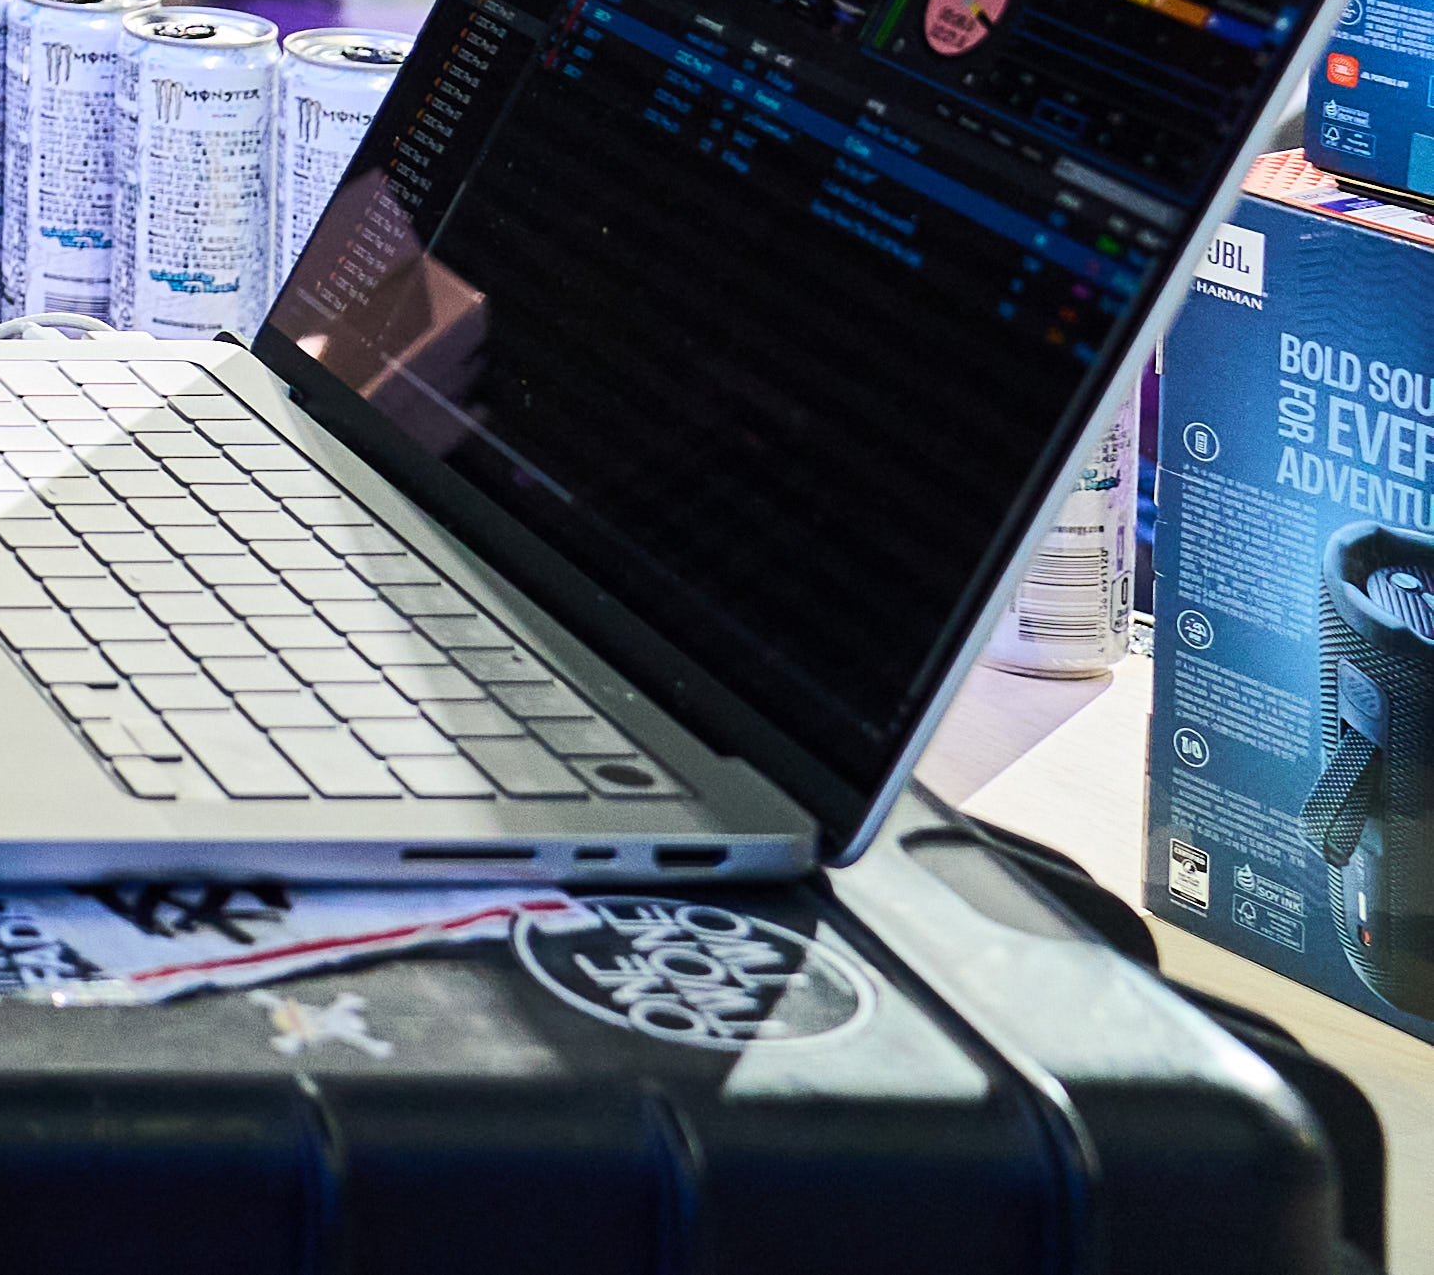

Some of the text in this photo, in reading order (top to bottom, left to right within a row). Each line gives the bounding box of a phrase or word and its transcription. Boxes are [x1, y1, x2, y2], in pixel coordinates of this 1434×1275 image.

[1207, 238, 1250, 275] JBL
[1196, 279, 1264, 311] HARMAN
[1279, 332, 1362, 393] BOLD
[1278, 379, 1316, 445] FOR
